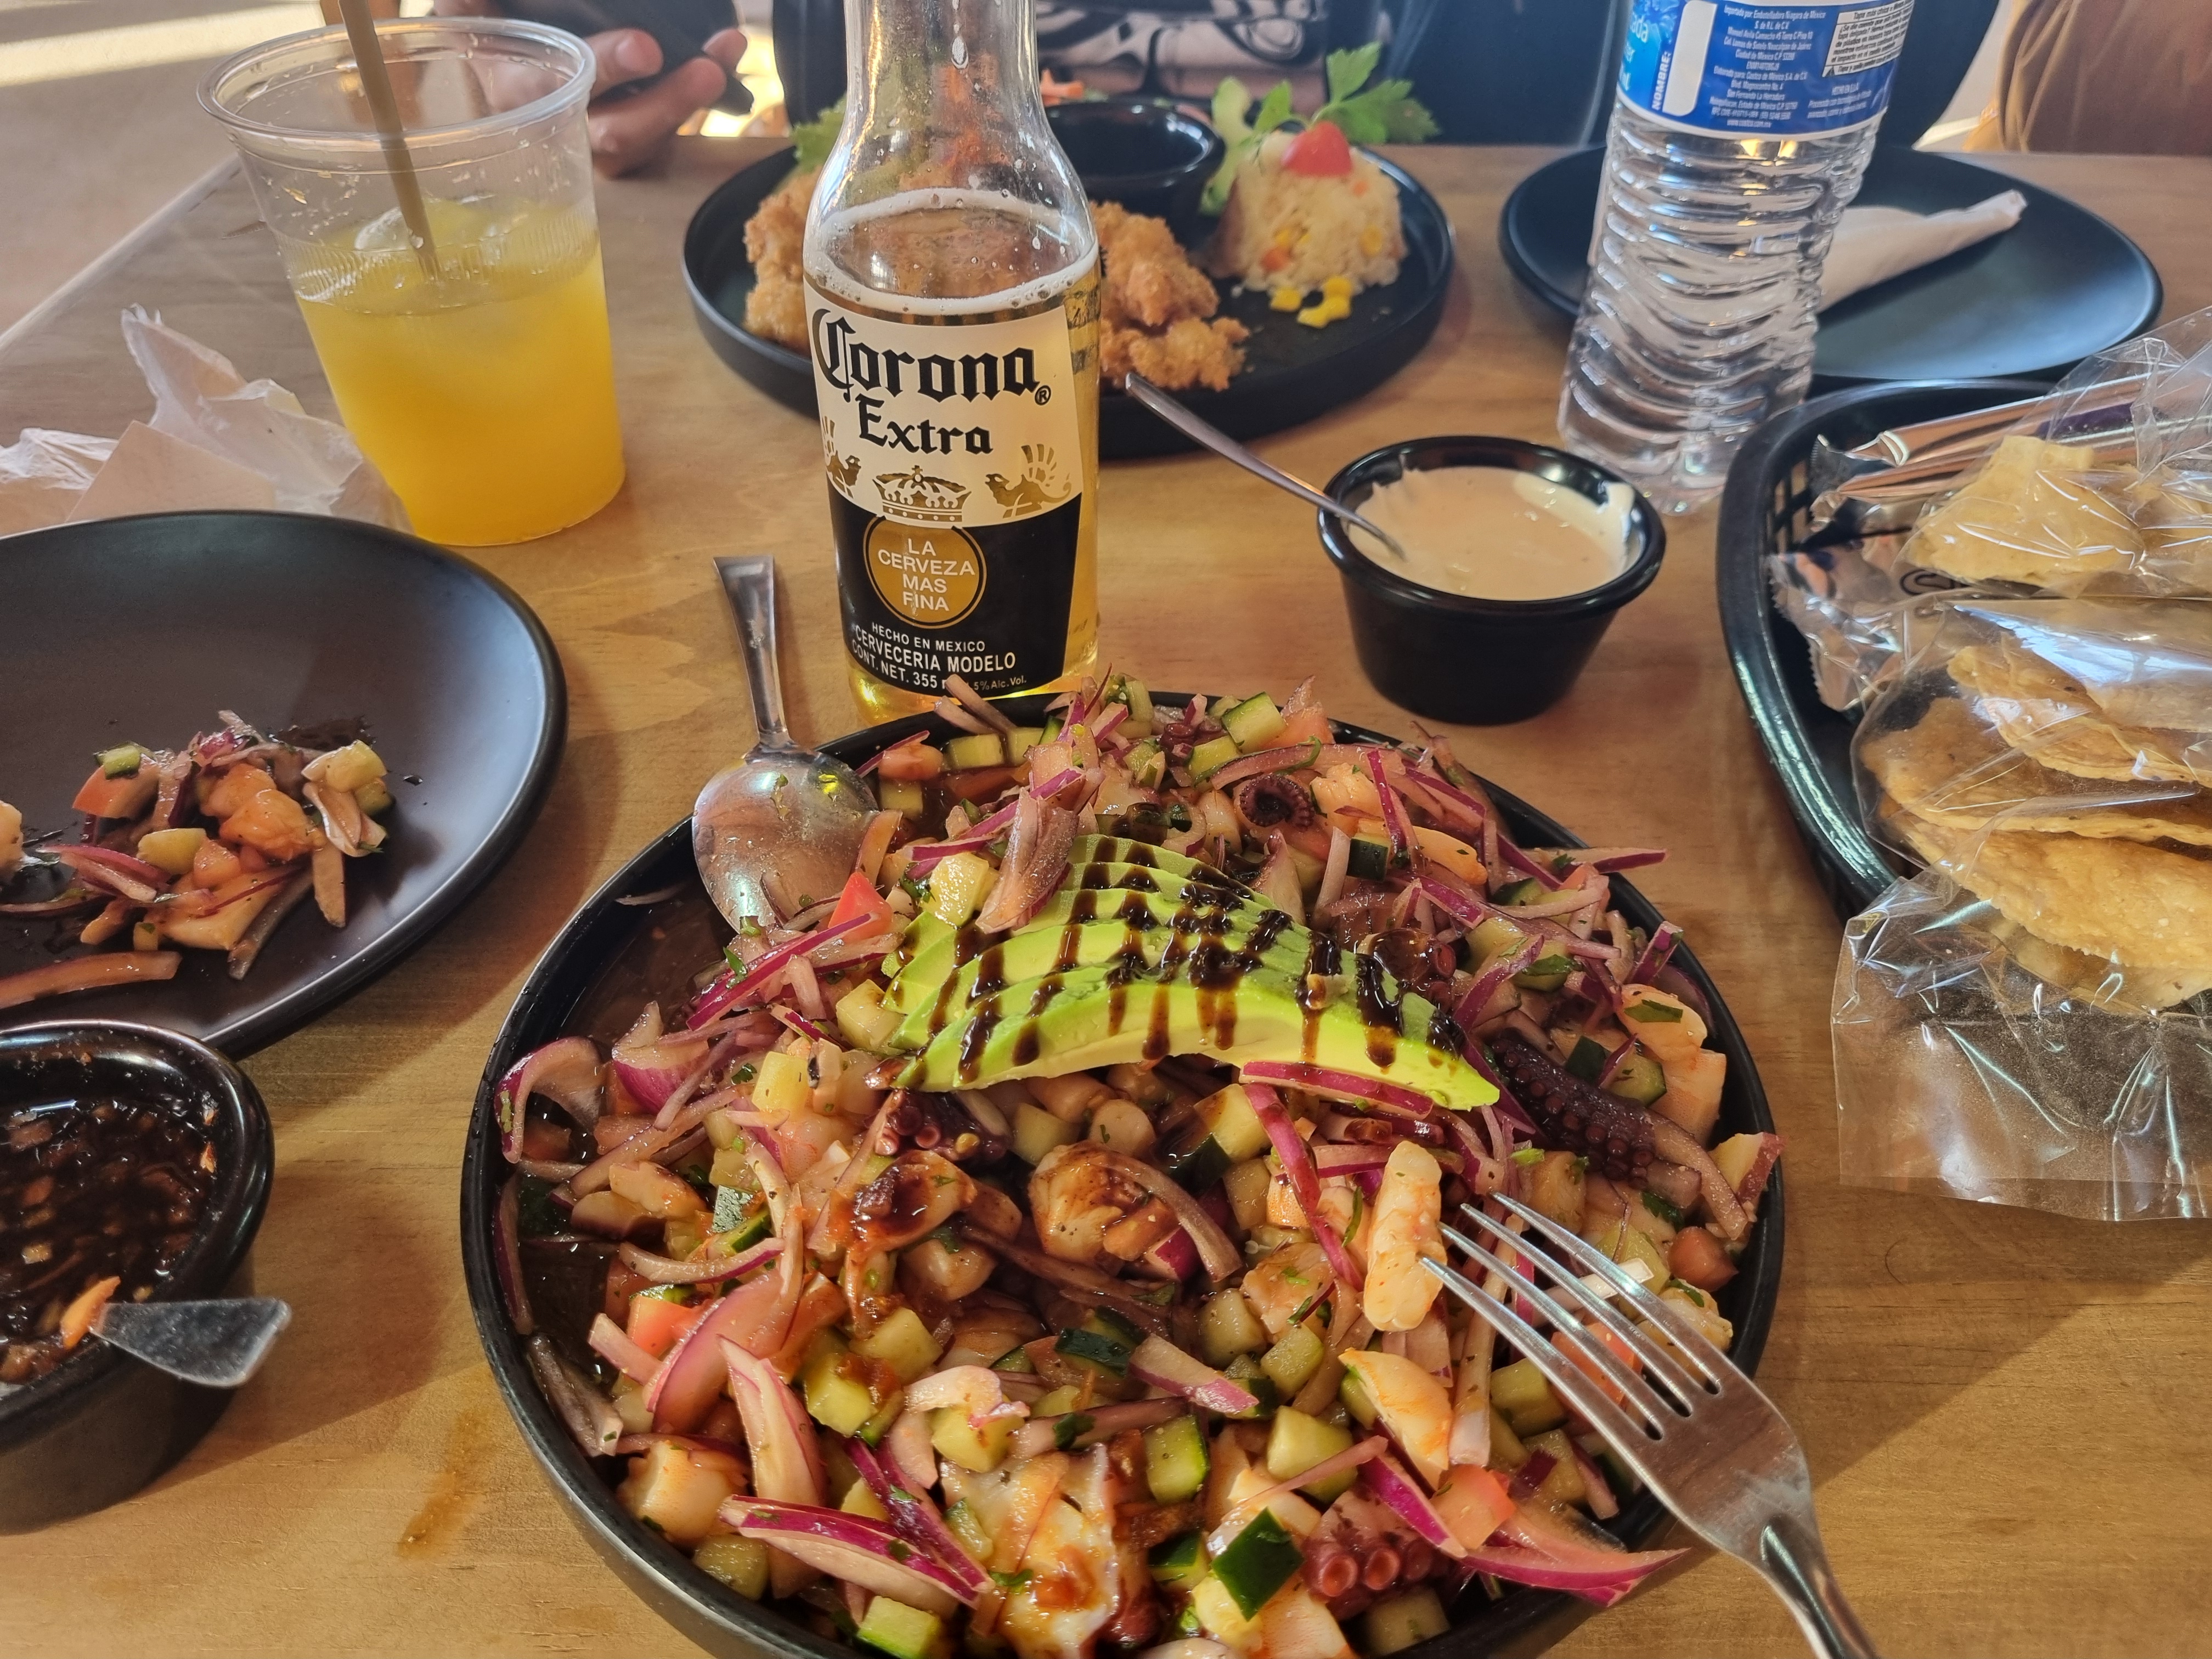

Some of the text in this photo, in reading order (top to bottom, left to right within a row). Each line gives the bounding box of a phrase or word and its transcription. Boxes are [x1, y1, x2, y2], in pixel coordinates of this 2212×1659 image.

[812, 308, 1040, 403] Corona
[855, 393, 994, 455] Extra
[908, 538, 936, 556] LA
[878, 549, 975, 576] CERVEZA
[902, 574, 947, 594] MAS
[902, 591, 950, 612] FINA
[855, 624, 1015, 673] CERVECERIA MODELO
[872, 622, 985, 652] HECHO EN MEXICO
[852, 639, 878, 670] CONT.
[881, 660, 909, 683] NET.
[913, 672, 938, 689] 355
